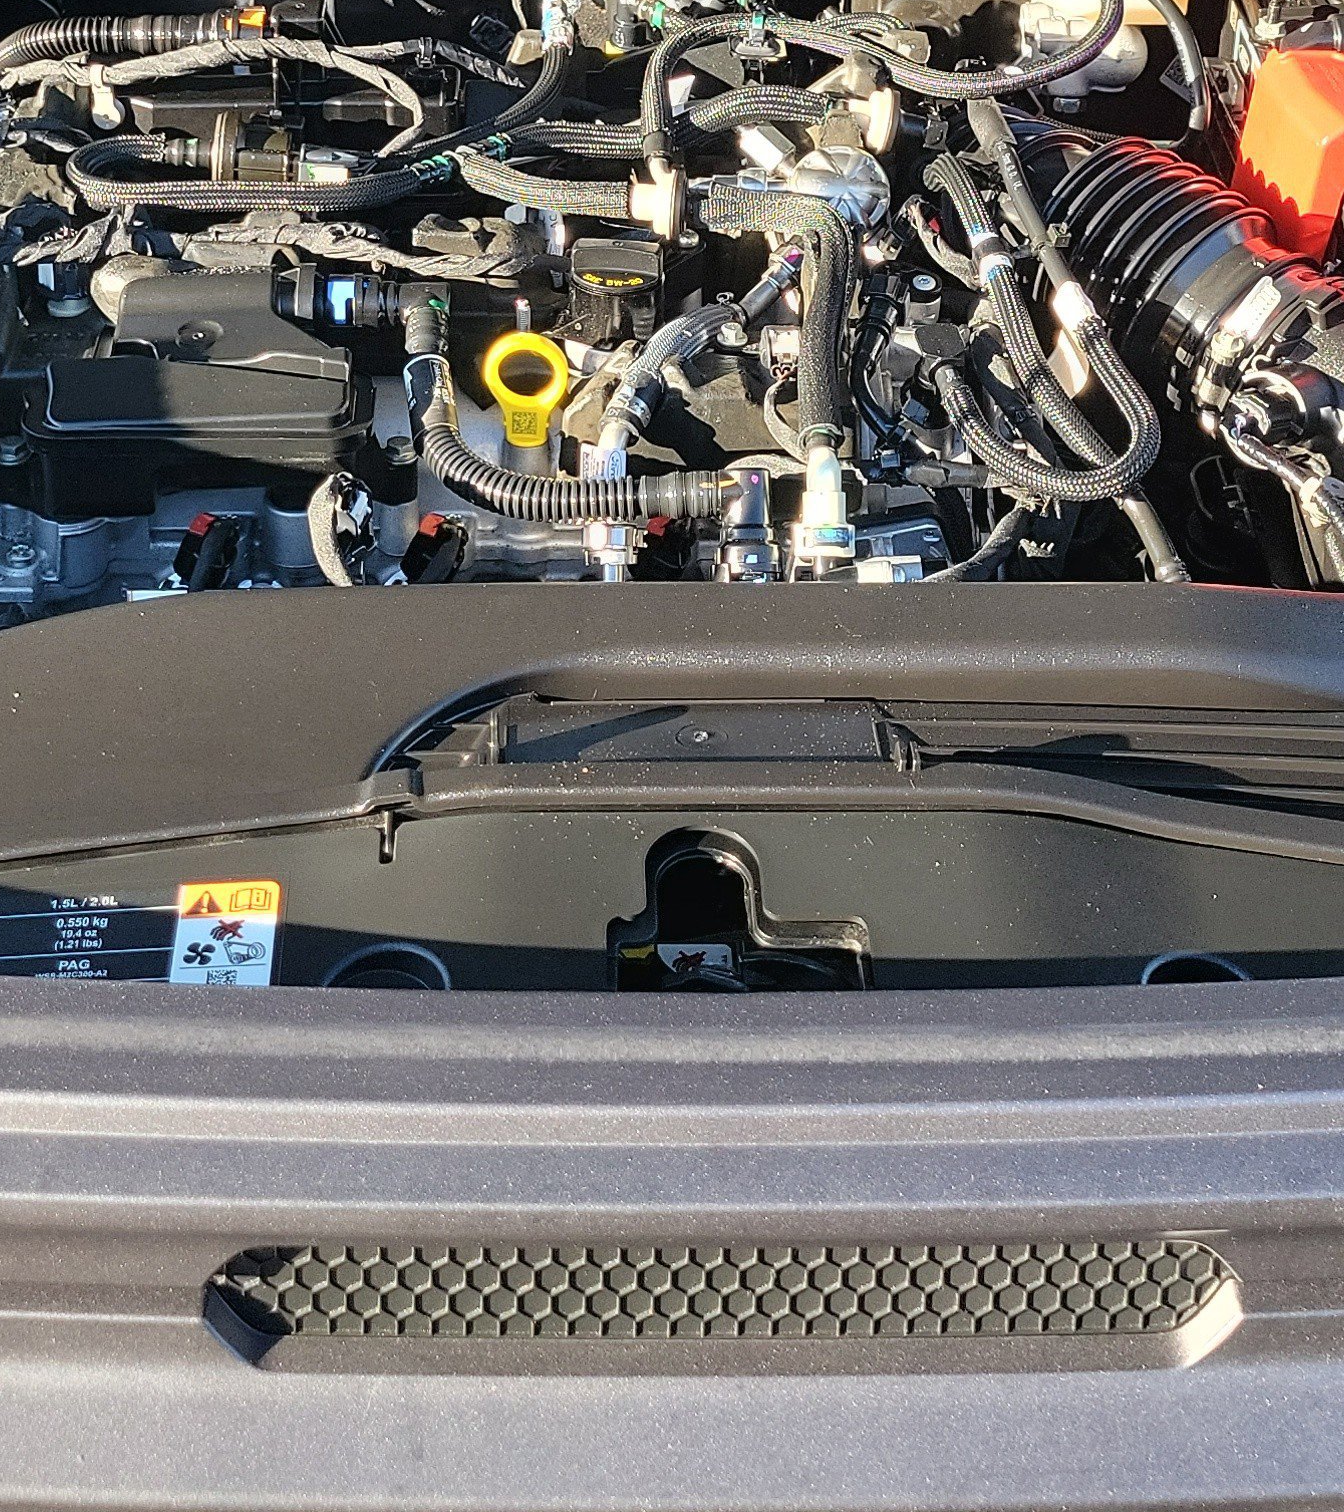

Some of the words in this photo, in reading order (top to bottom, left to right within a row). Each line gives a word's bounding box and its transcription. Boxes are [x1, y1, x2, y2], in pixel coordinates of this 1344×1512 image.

[51, 899, 78, 909] 1.5L
[89, 895, 118, 907] 2.0L
[56, 917, 89, 928] 0.550
[93, 916, 109, 928] kg
[62, 929, 82, 938] 19.4
[54, 940, 79, 951] (1.21
[82, 938, 102, 948] lbs)
[58, 959, 90, 971] PAG
